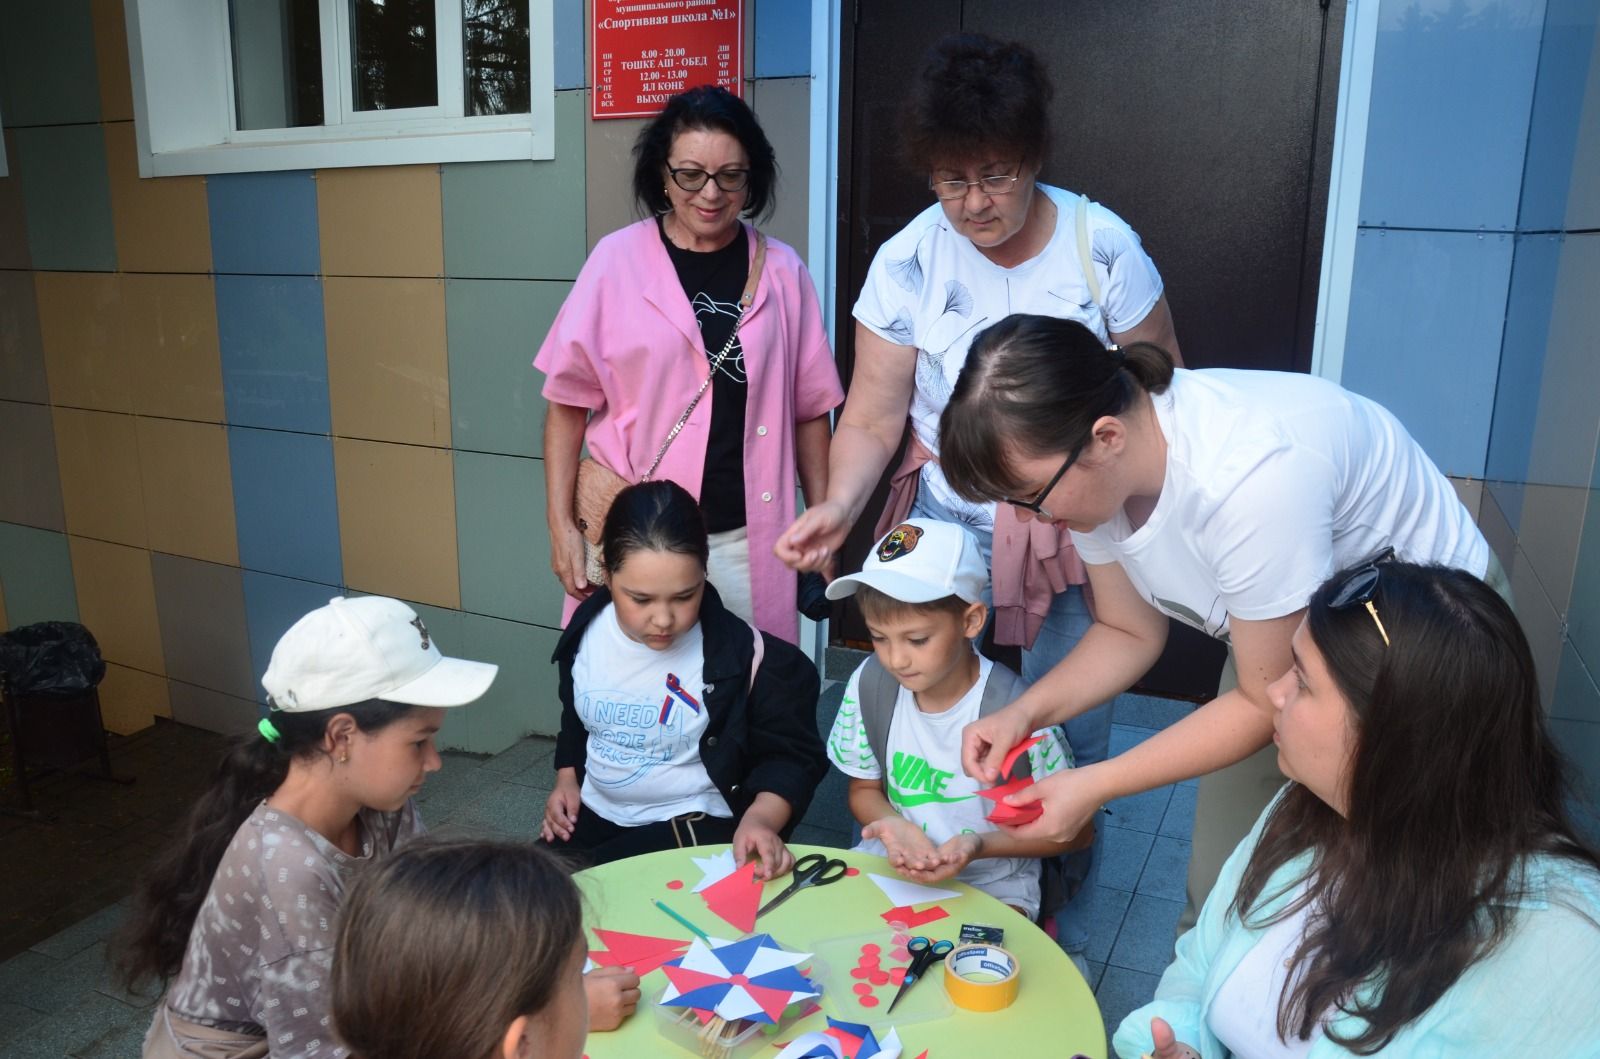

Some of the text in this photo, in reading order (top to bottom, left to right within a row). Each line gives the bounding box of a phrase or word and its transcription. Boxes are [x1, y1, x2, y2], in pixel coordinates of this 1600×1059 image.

[616, 0, 717, 14] муниципального района
[598, 8, 736, 31] «Спортивная школа №1»
[641, 49, 658, 59] 8.00
[664, 47, 686, 57] 20.00
[620, 59, 656, 71] ТӨШКЕ
[657, 58, 674, 69] АШ
[680, 55, 708, 67] ОБЕД
[639, 71, 660, 81] 12.00
[667, 69, 688, 79] 13.00
[642, 80, 685, 92] ЯЛ КӨНЕ
[636, 93, 674, 104] ВЫХОД
[583, 696, 659, 728] I NEED
[890, 751, 955, 795] NIKE
